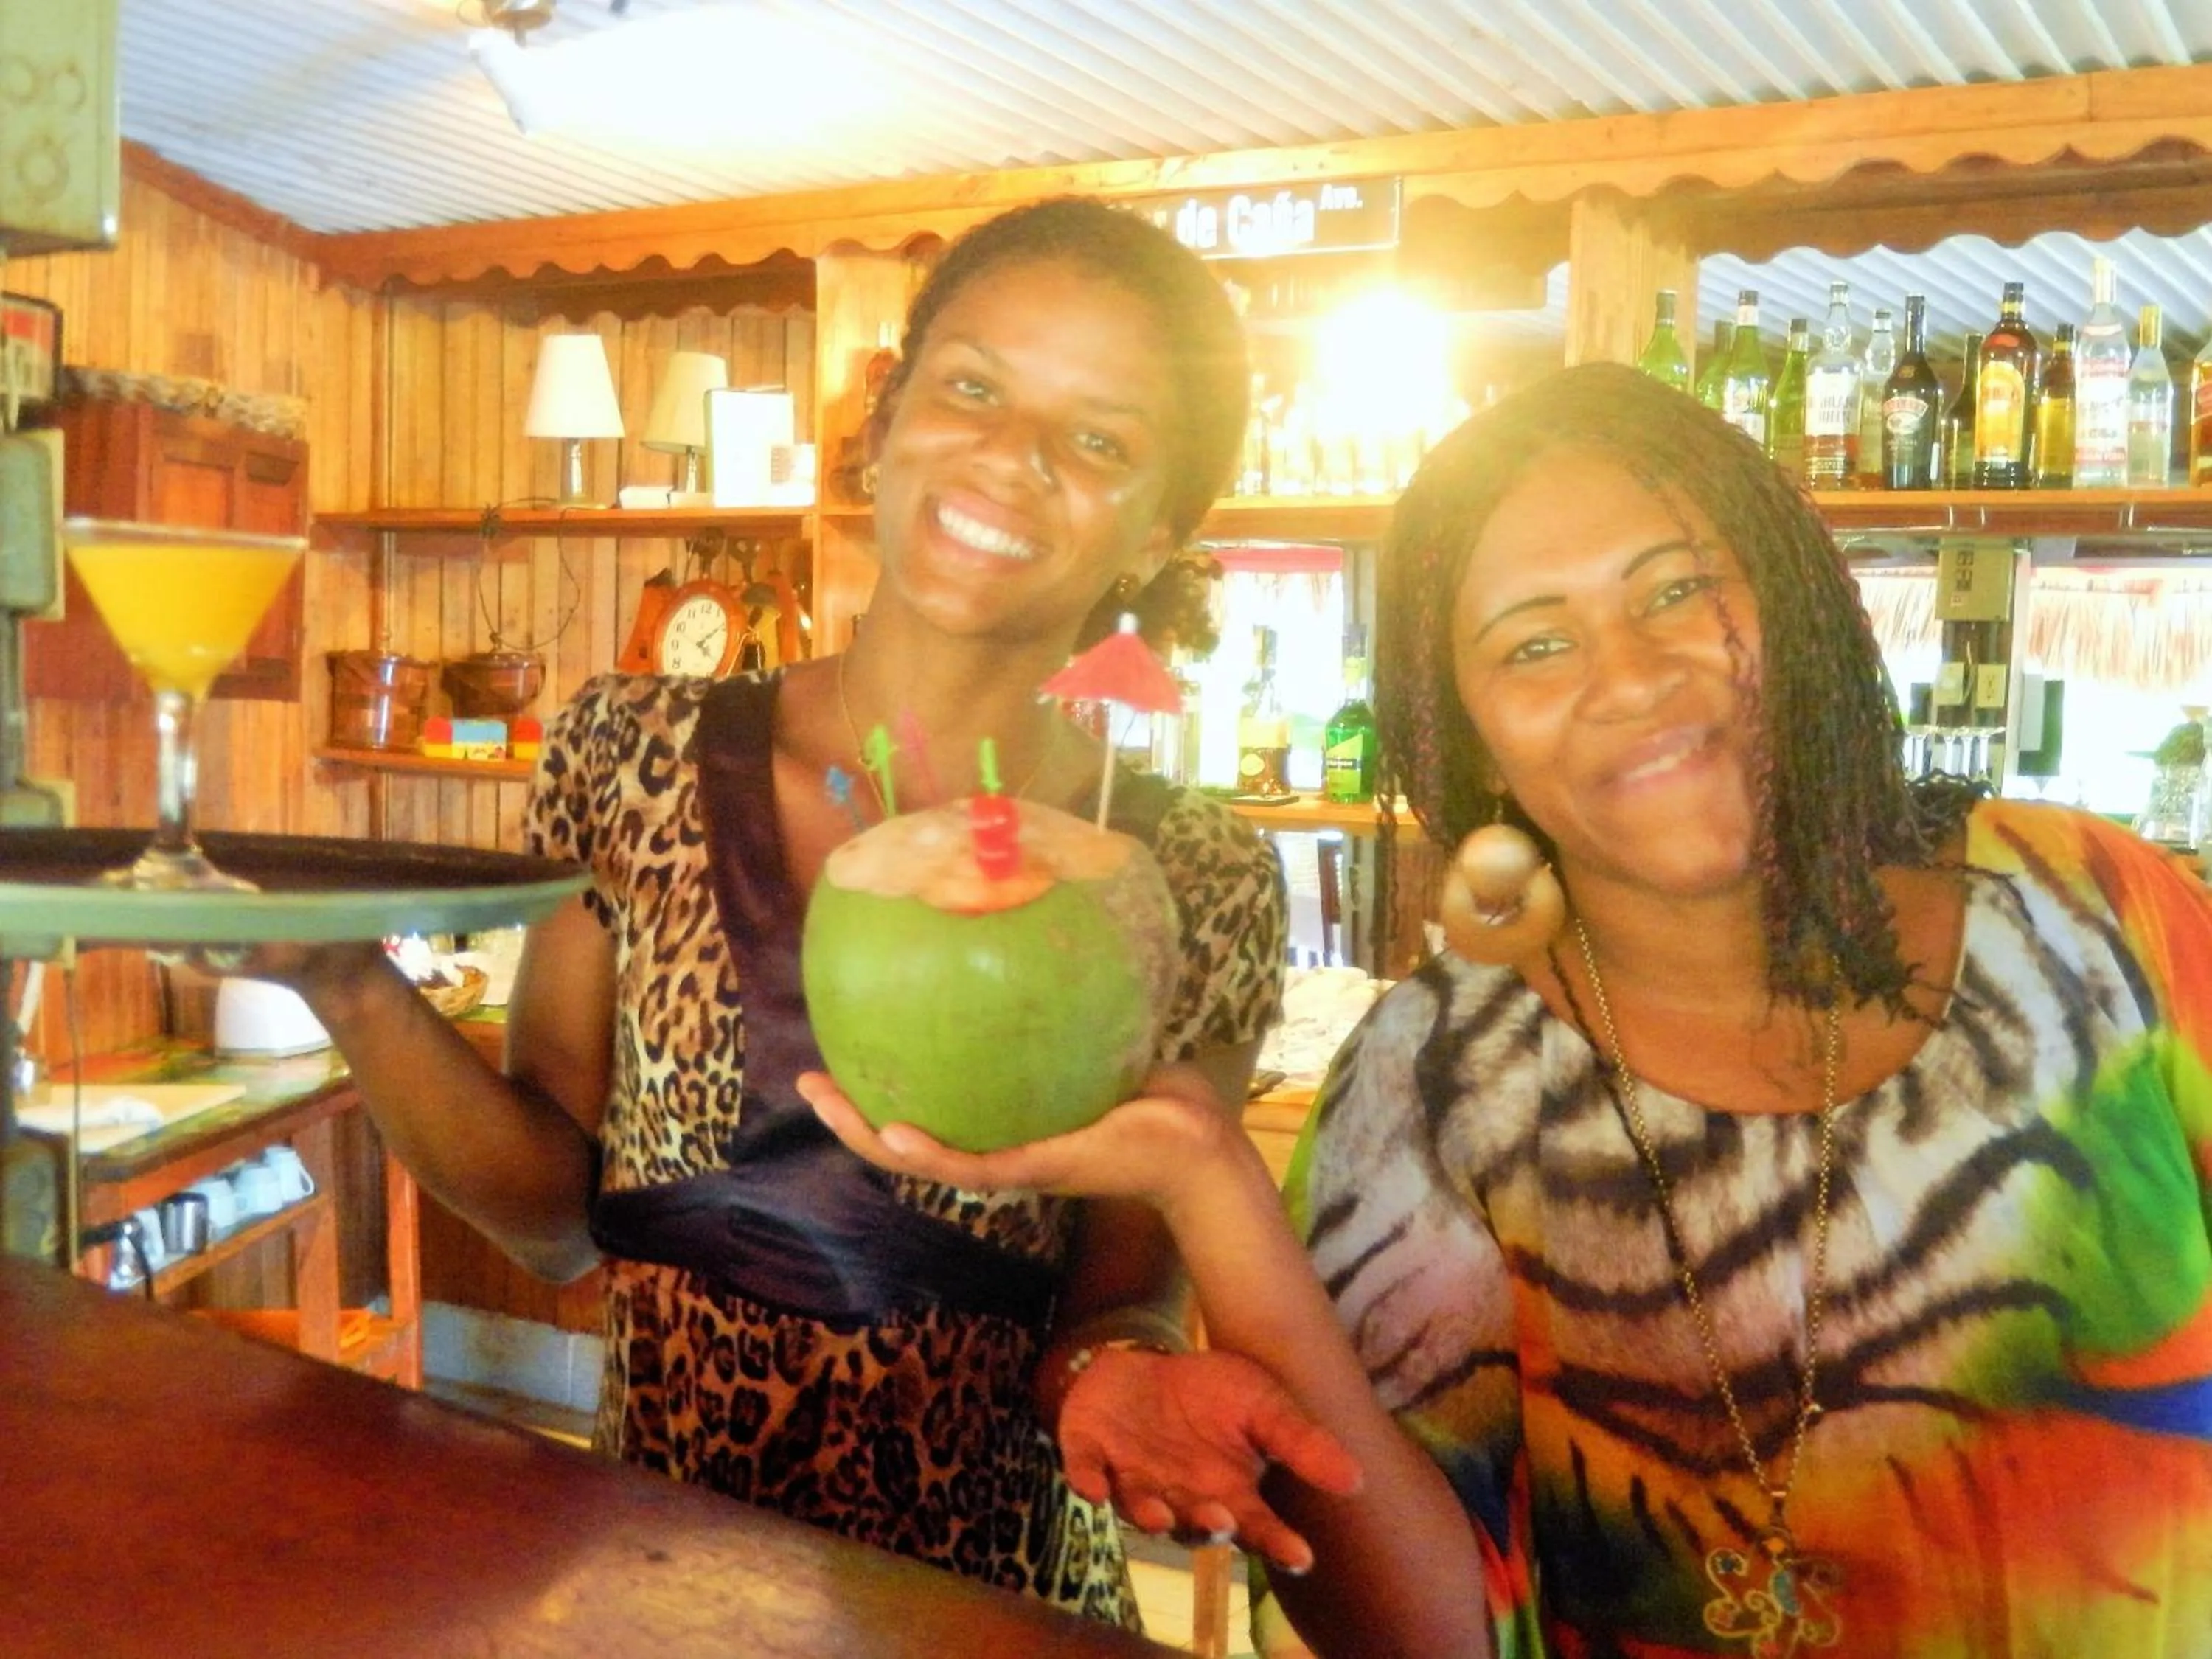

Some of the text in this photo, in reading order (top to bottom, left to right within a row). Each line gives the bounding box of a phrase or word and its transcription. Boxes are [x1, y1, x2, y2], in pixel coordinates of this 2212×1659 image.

[1177, 198, 1217, 248] de
[1227, 191, 1314, 251] Caña
[701, 602, 712, 614] 12
